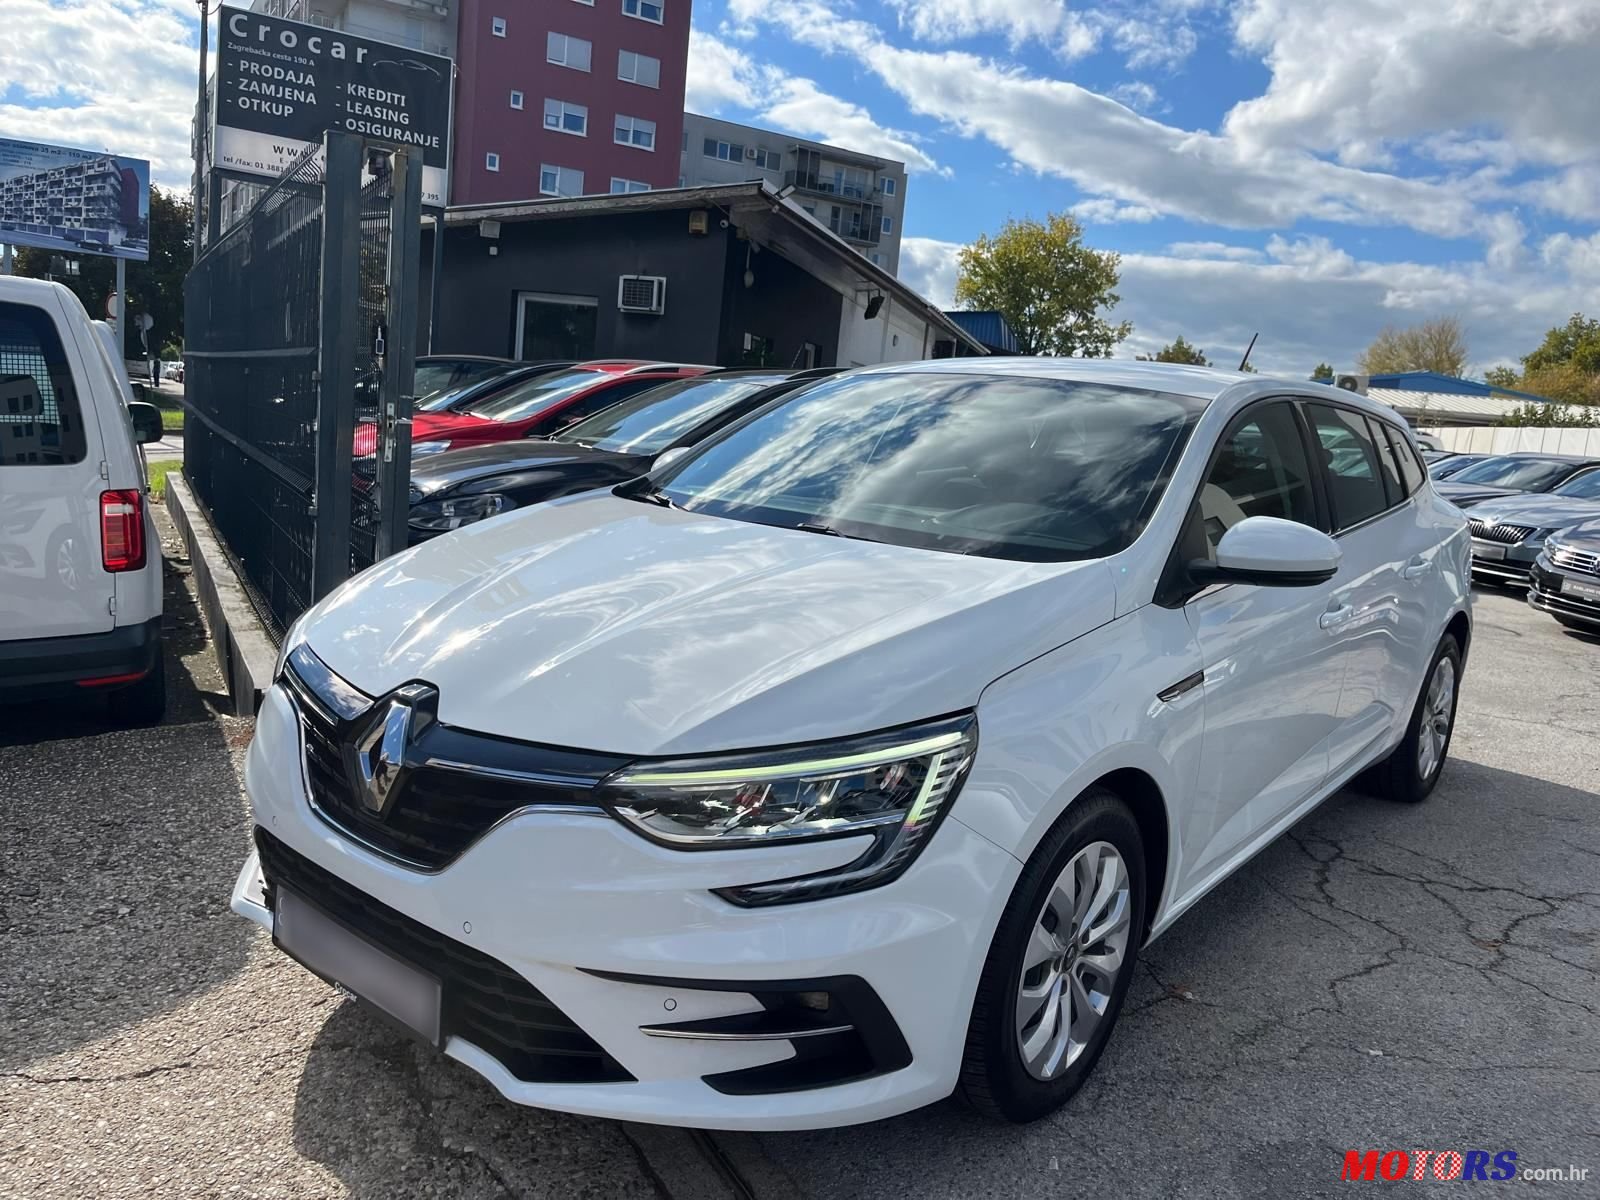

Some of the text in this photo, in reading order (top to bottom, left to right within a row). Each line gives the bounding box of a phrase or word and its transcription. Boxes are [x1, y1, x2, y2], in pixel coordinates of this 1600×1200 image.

[229, 14, 368, 64] Crocar
[272, 52, 292, 62] cesta
[294, 56, 307, 65] 190
[309, 59, 315, 67] A
[239, 59, 316, 87] PRODAJA
[238, 78, 317, 105] ZAMJENA
[347, 82, 406, 107] KREDITI
[238, 96, 294, 117] OTKUP
[346, 100, 409, 125] LEASING
[345, 118, 440, 148] OSIGURANJE
